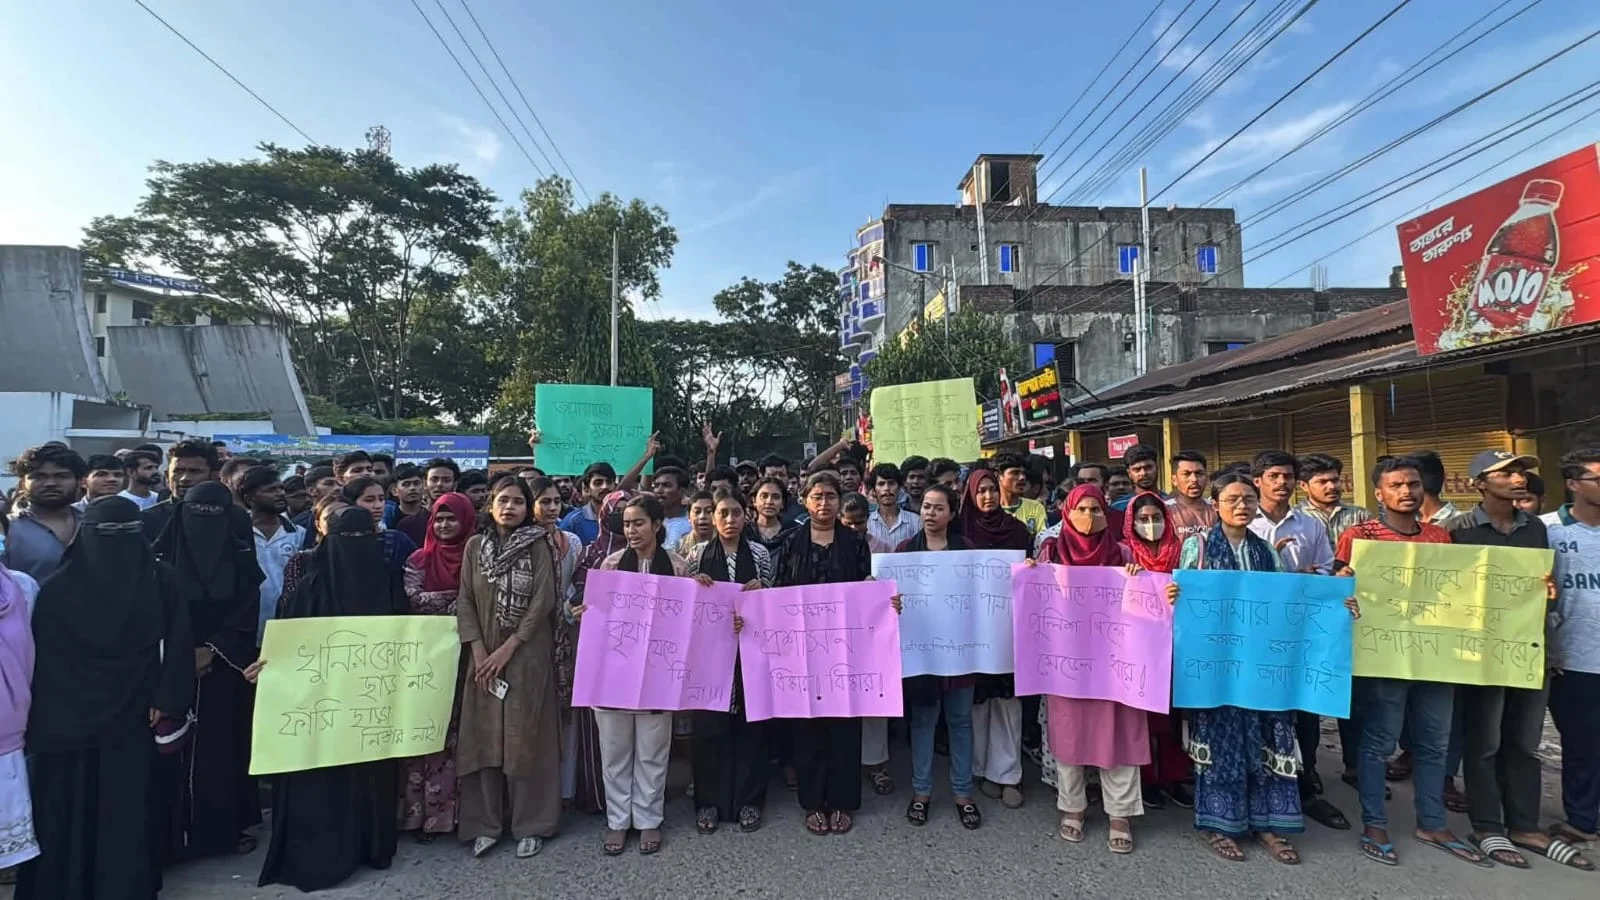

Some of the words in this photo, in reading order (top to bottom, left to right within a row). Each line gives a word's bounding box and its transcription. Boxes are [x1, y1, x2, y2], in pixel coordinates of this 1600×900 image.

[1422, 224, 1474, 262] তারুণ্য
[1478, 268, 1544, 307] MOJO
[1558, 541, 1579, 553] 34
[1186, 598, 1272, 626] আমার
[1282, 587, 1333, 634] ভাই
[1358, 626, 1444, 656] প্রশাসন
[1304, 660, 1342, 695] চাই
